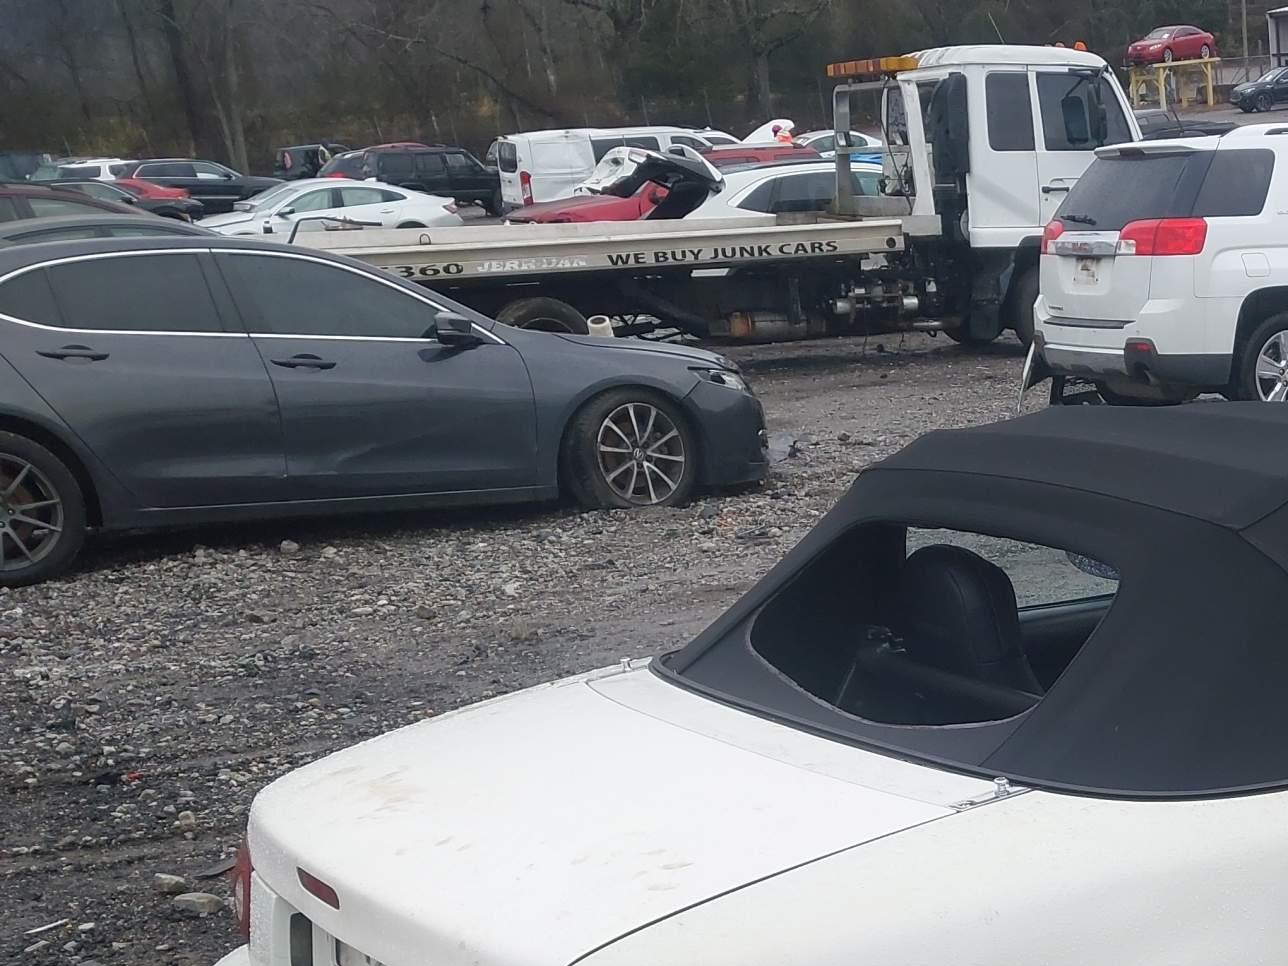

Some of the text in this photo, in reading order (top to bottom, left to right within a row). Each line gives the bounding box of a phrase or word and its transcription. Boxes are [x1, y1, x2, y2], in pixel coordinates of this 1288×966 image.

[607, 240, 839, 266] WE BUY JUNK CARS
